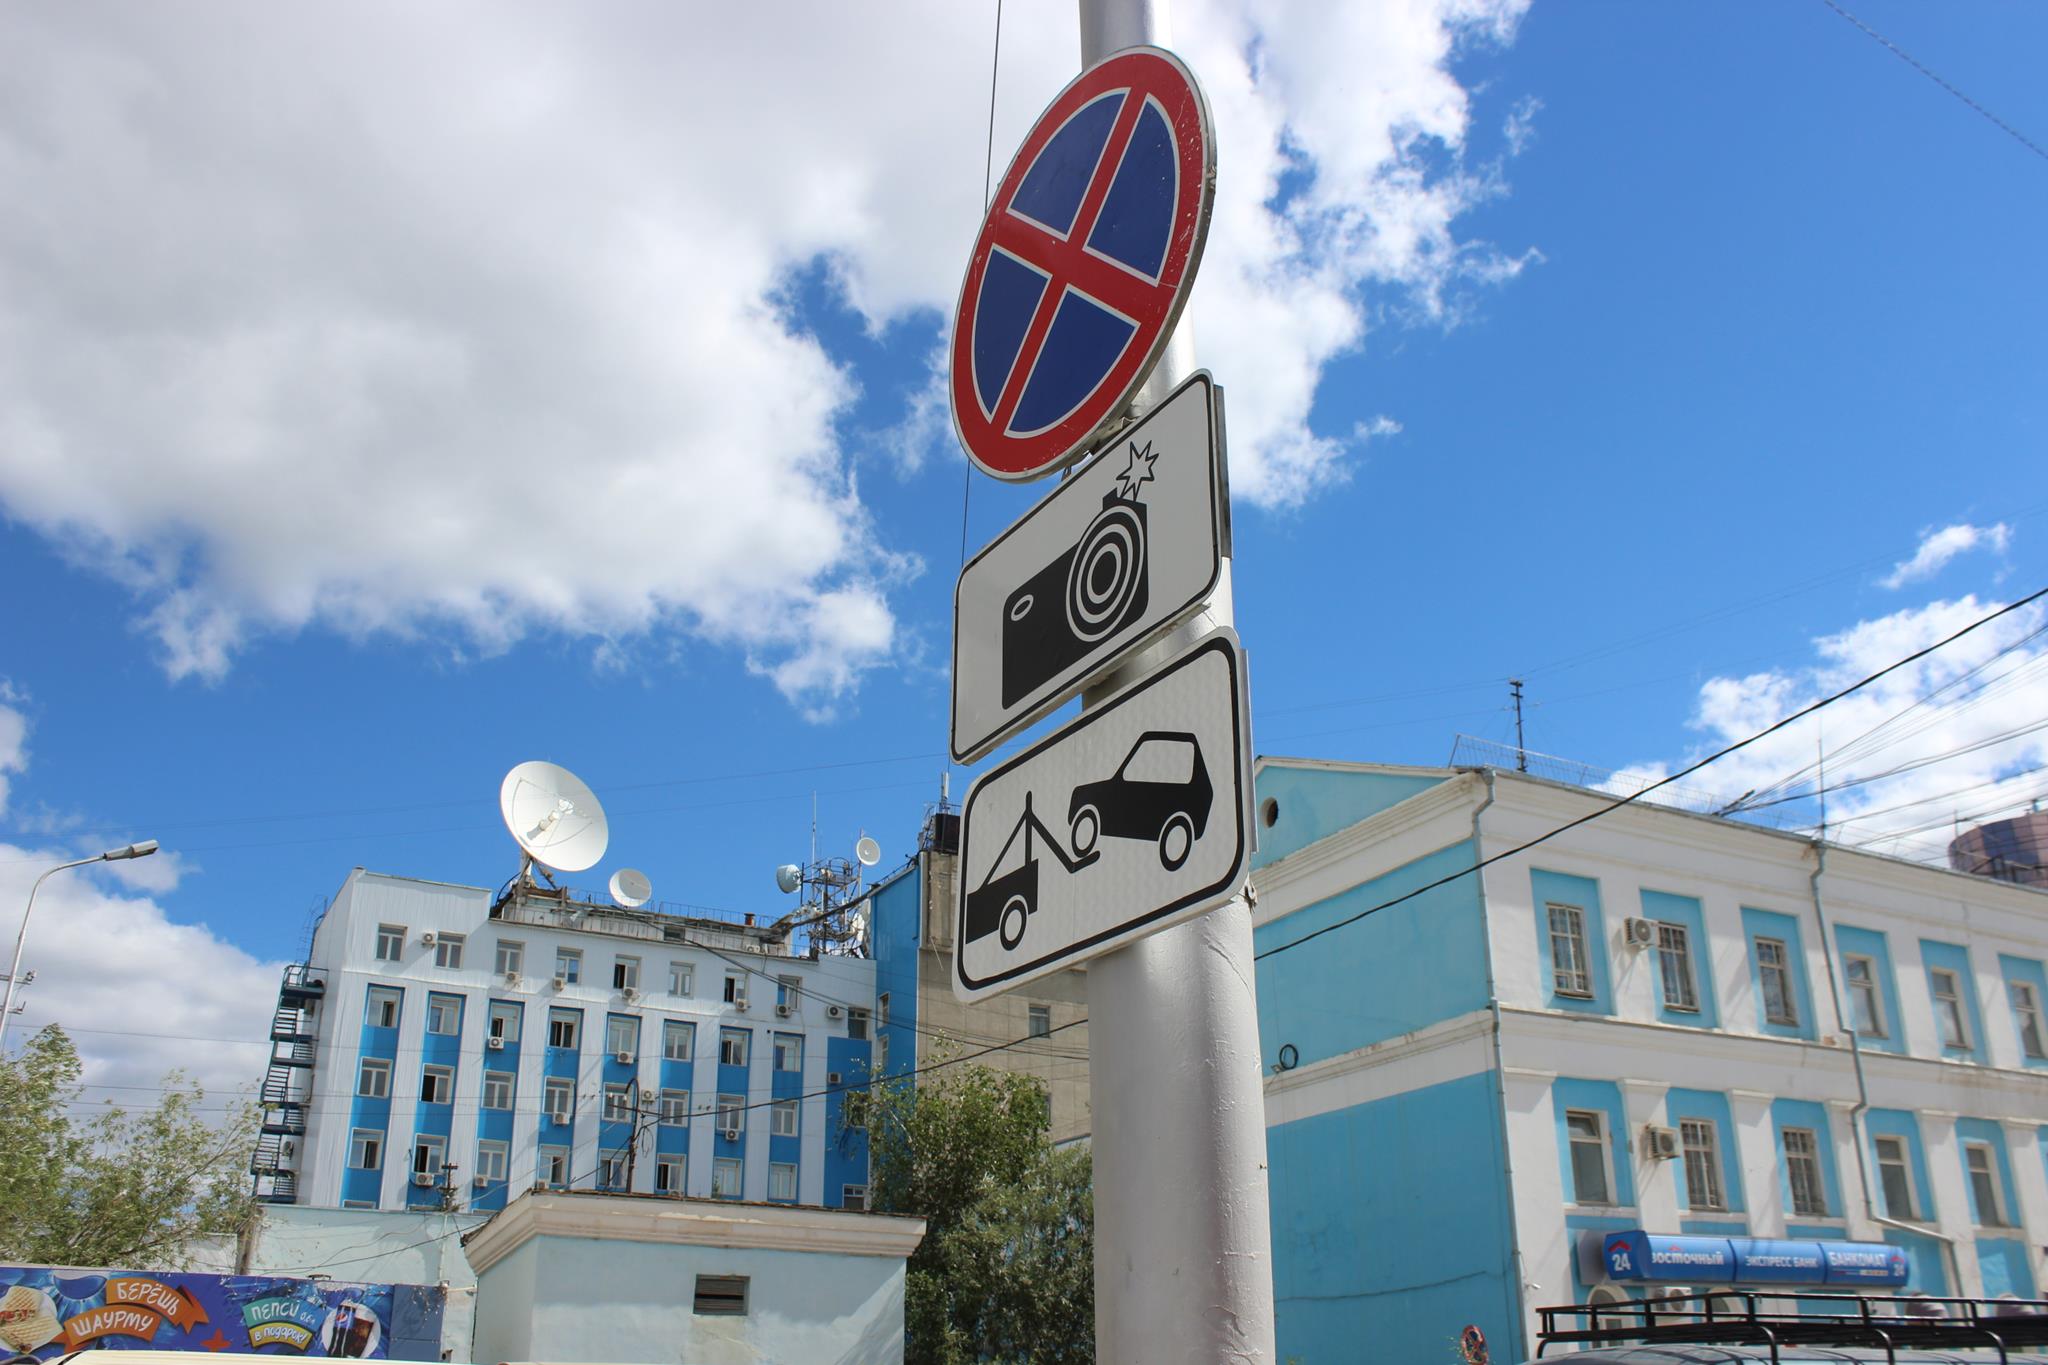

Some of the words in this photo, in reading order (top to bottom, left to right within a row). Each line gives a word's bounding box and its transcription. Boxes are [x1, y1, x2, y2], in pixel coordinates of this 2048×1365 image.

[1612, 1253, 1631, 1272] 24
[1745, 1256, 1792, 1268] ЭКСПРЕСС
[1793, 1257, 1819, 1268] БАНК
[1828, 1252, 1887, 1267] БАНКОМАТ
[116, 1283, 180, 1316] БЕРЁШЬ
[72, 1311, 153, 1336] ШАУРМУ
